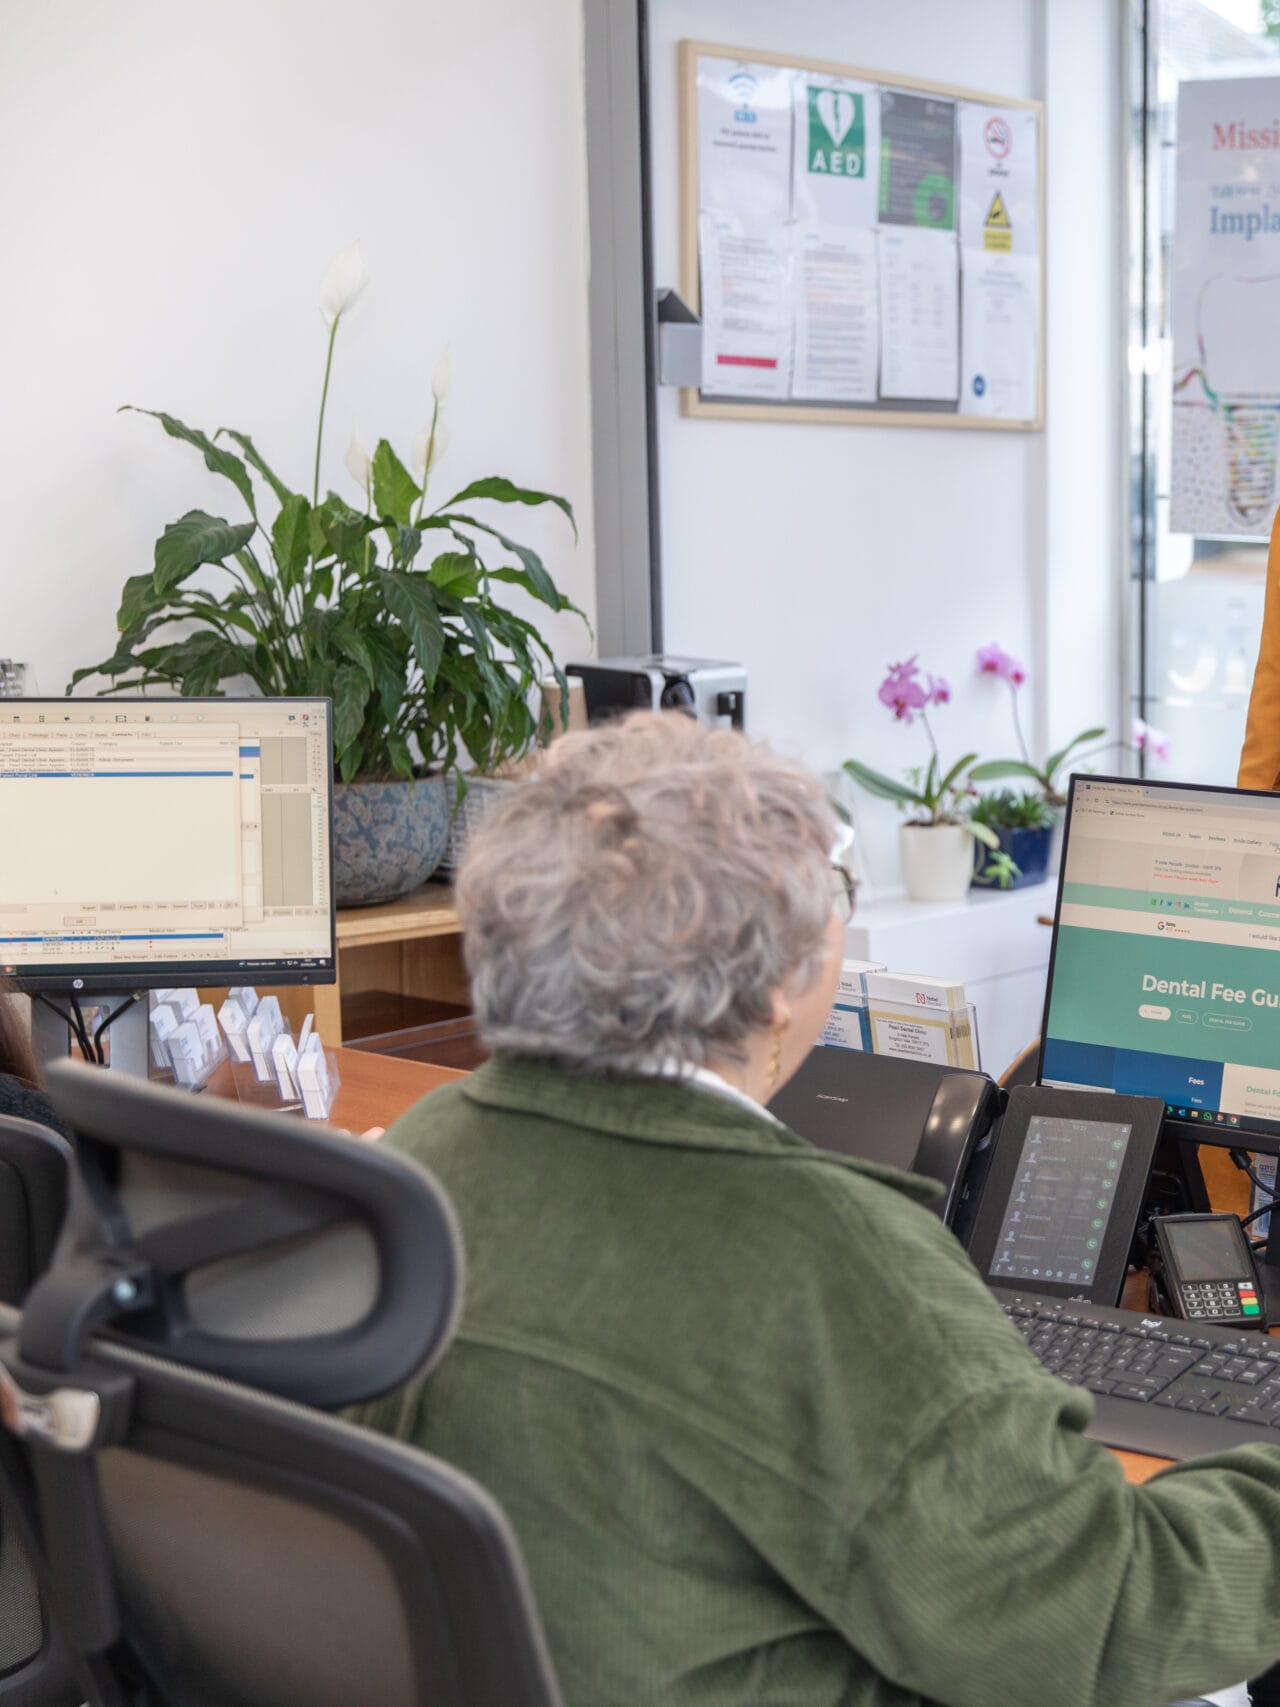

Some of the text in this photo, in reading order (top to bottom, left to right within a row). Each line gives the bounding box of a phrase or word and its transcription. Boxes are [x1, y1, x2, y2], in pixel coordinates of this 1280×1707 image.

[812, 155, 862, 177] AED
[1142, 974, 1206, 999] Dental
[1211, 983, 1247, 1003] Fee
[1188, 1076, 1205, 1085] Fees
[1246, 1086, 1271, 1097] Dental
[1141, 1318, 1162, 1329] logi
